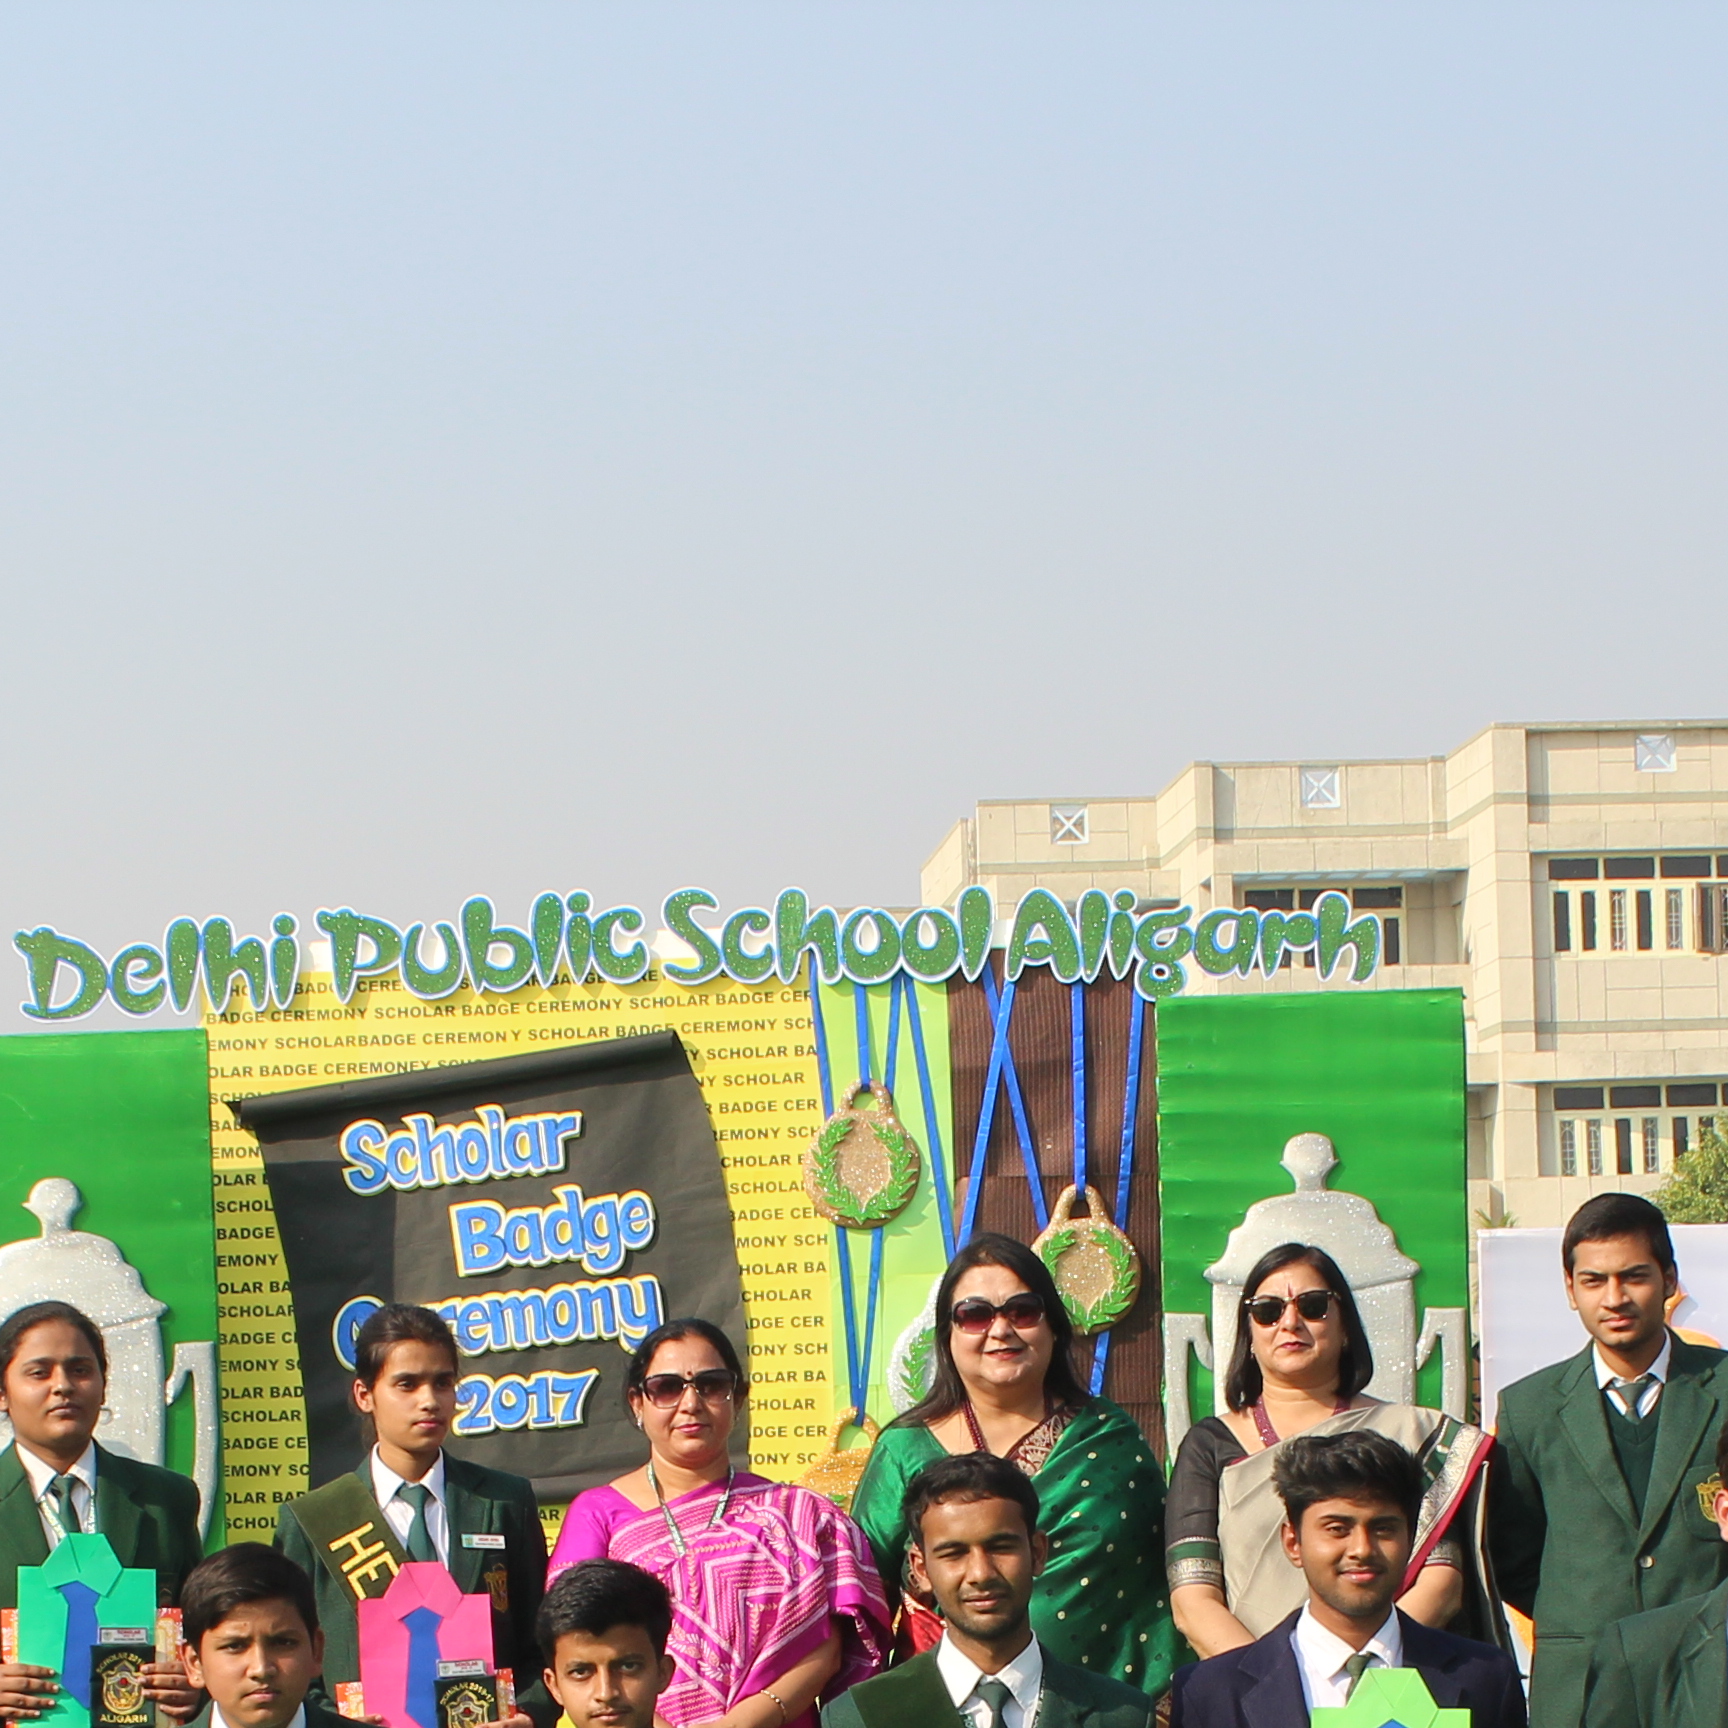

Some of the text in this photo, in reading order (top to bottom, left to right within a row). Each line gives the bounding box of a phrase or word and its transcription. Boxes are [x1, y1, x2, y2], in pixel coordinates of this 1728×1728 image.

[14, 886, 1380, 1021] Delhi Public School Aligarh
[206, 1011, 264, 1025] BADGE
[271, 1008, 367, 1022] CEREMONY
[374, 1005, 455, 1018] SCHOLAR
[462, 1003, 520, 1017] BADGE
[526, 999, 622, 1014] CEREMONY
[629, 994, 709, 1009] SCHOLAR
[715, 991, 774, 1005] BADGE
[528, 1026, 609, 1041] SCHOLAR
[681, 1018, 778, 1034] CEREMONY
[260, 1062, 317, 1077] BADGE
[707, 1045, 788, 1061] SCHOLAR
[722, 1072, 805, 1087] SCHOLAR
[719, 1098, 818, 1114] BADGE CER
[339, 1104, 583, 1195] Scholar
[213, 1173, 256, 1187] OLAR
[216, 1227, 275, 1240] BADGE
[448, 1184, 656, 1277] Badge
[736, 1234, 828, 1249] MONY SCH
[217, 1254, 279, 1267] EMONY
[804, 1261, 827, 1273] BA
[218, 1281, 263, 1295] OLAR
[790, 1316, 825, 1328] CER
[219, 1331, 276, 1345] BADGE
[793, 1343, 828, 1356] SCH
[221, 1359, 280, 1372] EMONY
[749, 1370, 827, 1385] OLAR BA
[221, 1386, 264, 1400] OLAR
[452, 1368, 600, 1436] 2017
[222, 1409, 302, 1423] SCHOLAR
[750, 1425, 828, 1439] DGE CER
[223, 1436, 279, 1450] BADGE
[796, 1453, 818, 1465] SC
[224, 1464, 282, 1477] EMONY
[100, 1714, 148, 1723] ALIGARH
